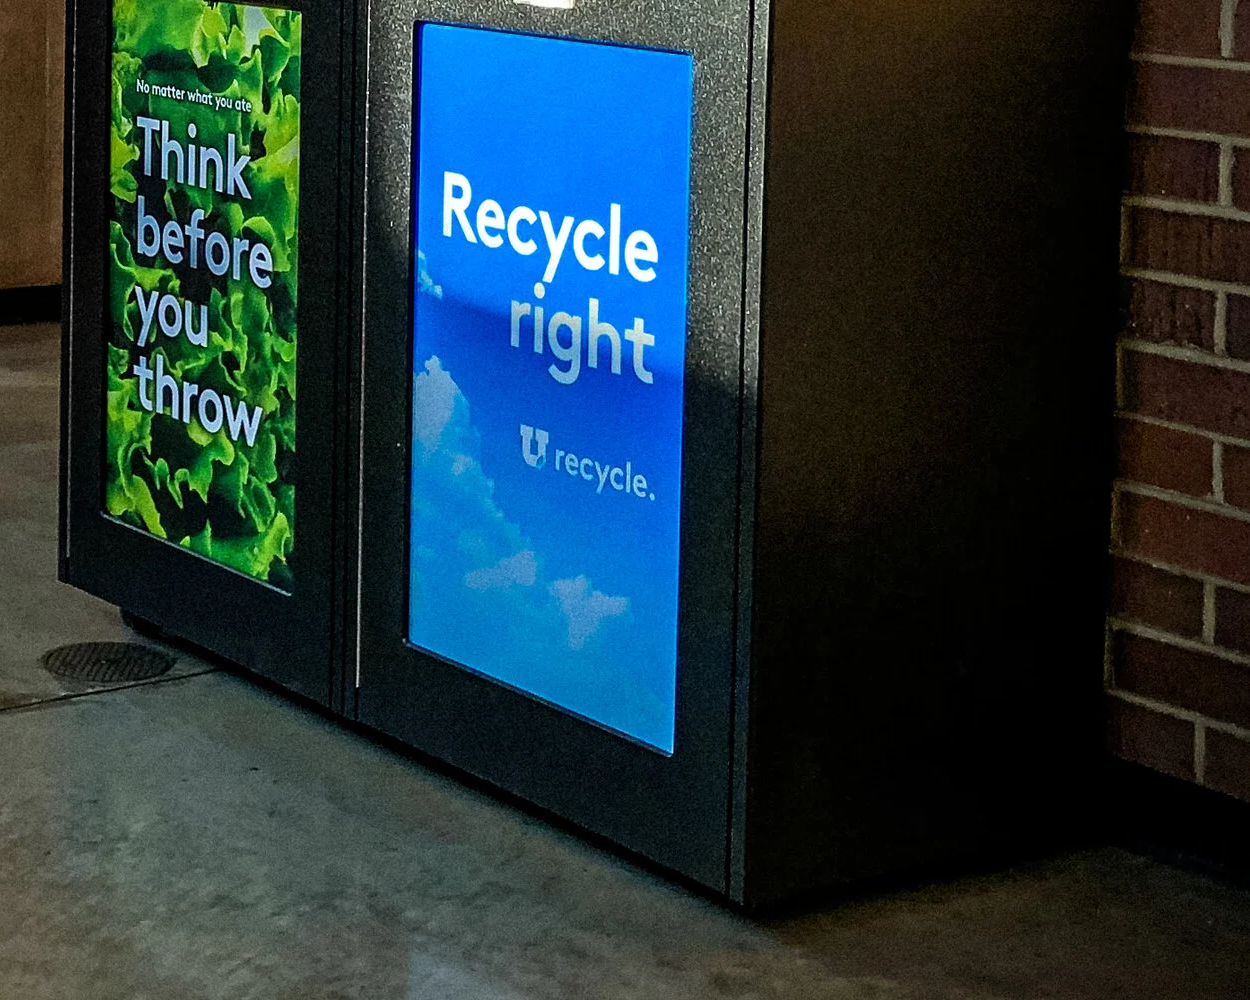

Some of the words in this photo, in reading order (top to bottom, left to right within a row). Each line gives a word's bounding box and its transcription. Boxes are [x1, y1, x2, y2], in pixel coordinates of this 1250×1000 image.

[136, 79, 150, 93] No
[151, 85, 185, 99] matter
[187, 89, 213, 105] what
[215, 96, 232, 111] you
[234, 98, 252, 112] ate
[136, 116, 252, 200] Think
[136, 195, 274, 289] before
[442, 171, 659, 283] Recycle
[134, 285, 208, 348] you
[510, 282, 655, 385] right
[133, 354, 263, 448] throw
[520, 424, 549, 470] U
[554, 448, 655, 501] recycle.
